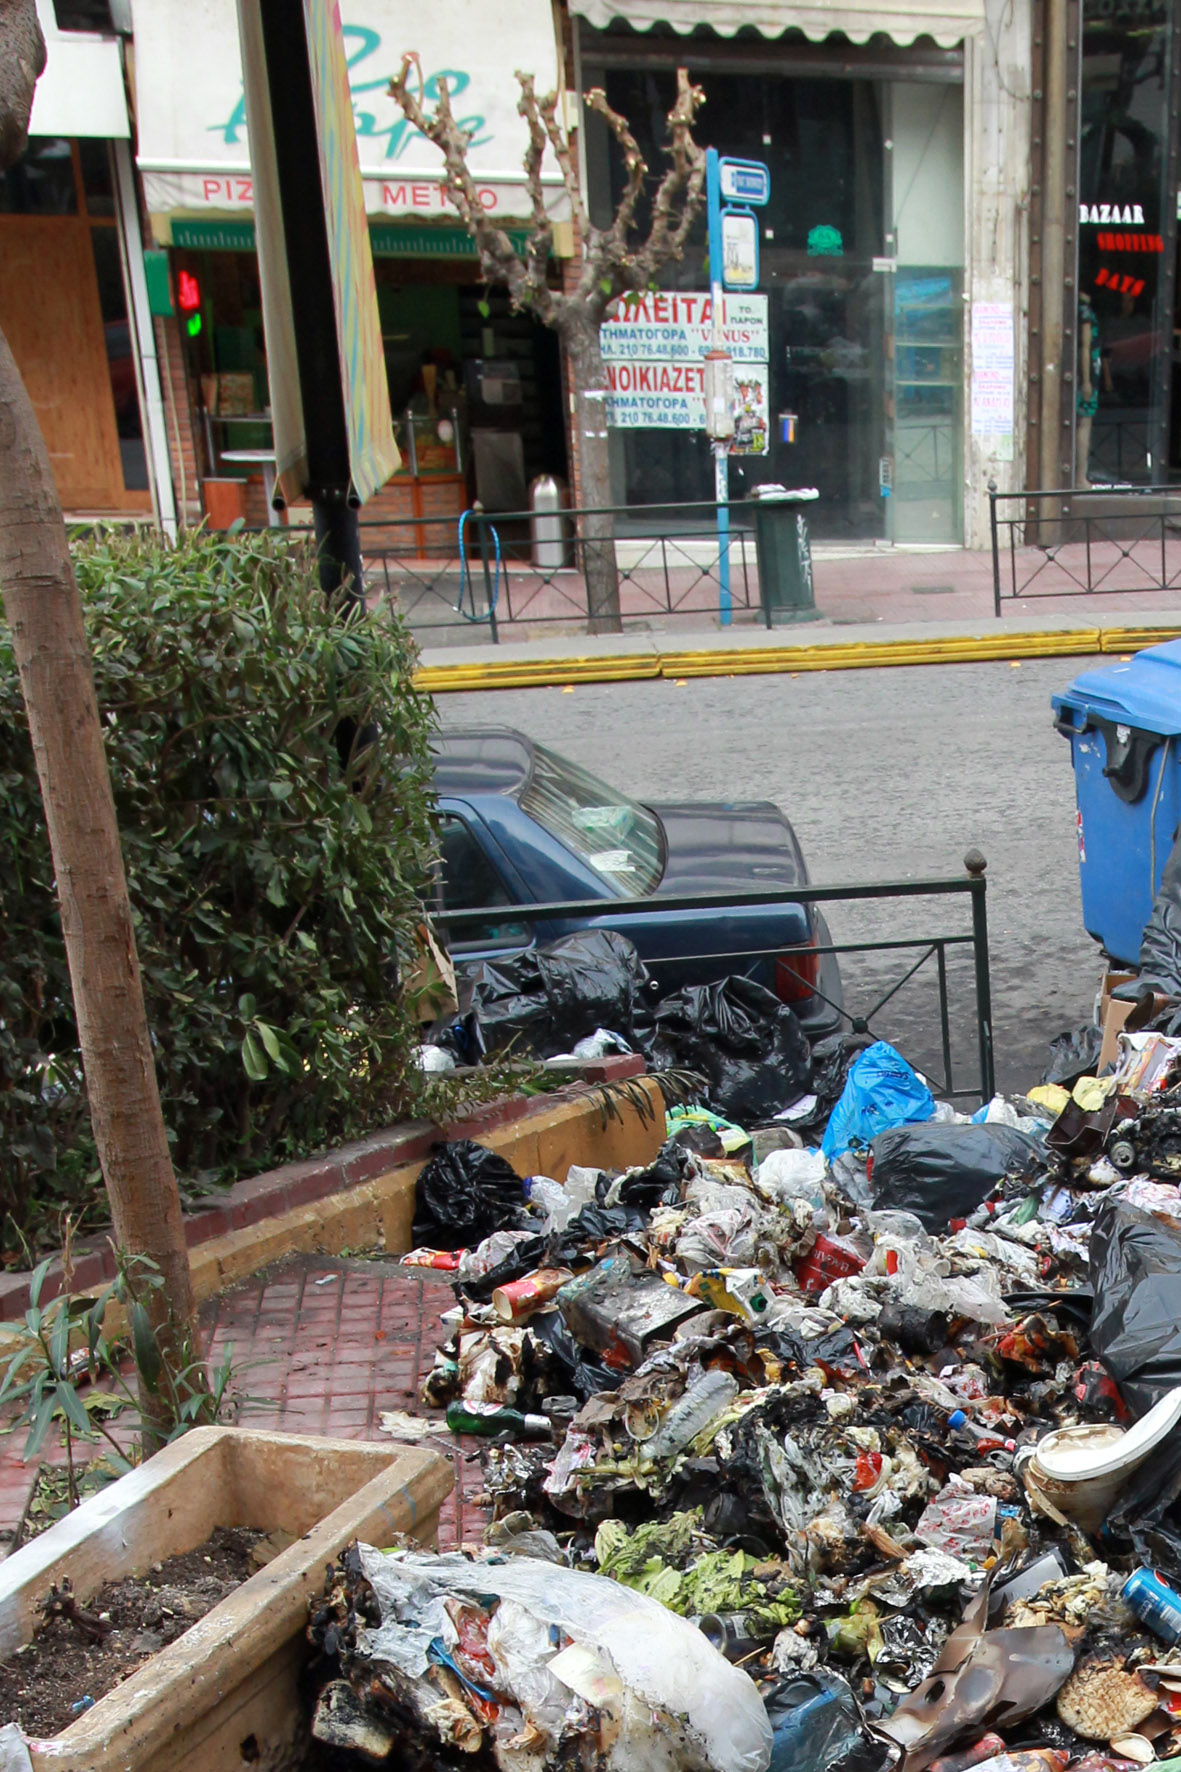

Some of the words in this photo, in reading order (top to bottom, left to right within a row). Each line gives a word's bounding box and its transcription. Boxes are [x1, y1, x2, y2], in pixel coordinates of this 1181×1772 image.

[383, 183, 499, 211] METO
[1078, 204, 1145, 225] BAZAAR
[610, 296, 727, 326] ΩΛΕΙΤΑΙ
[600, 328, 688, 342] ΤΗΜΑΤΟΓΟΡΑ
[604, 364, 705, 393] ΝΟΙΚΙΑΖΕΤ
